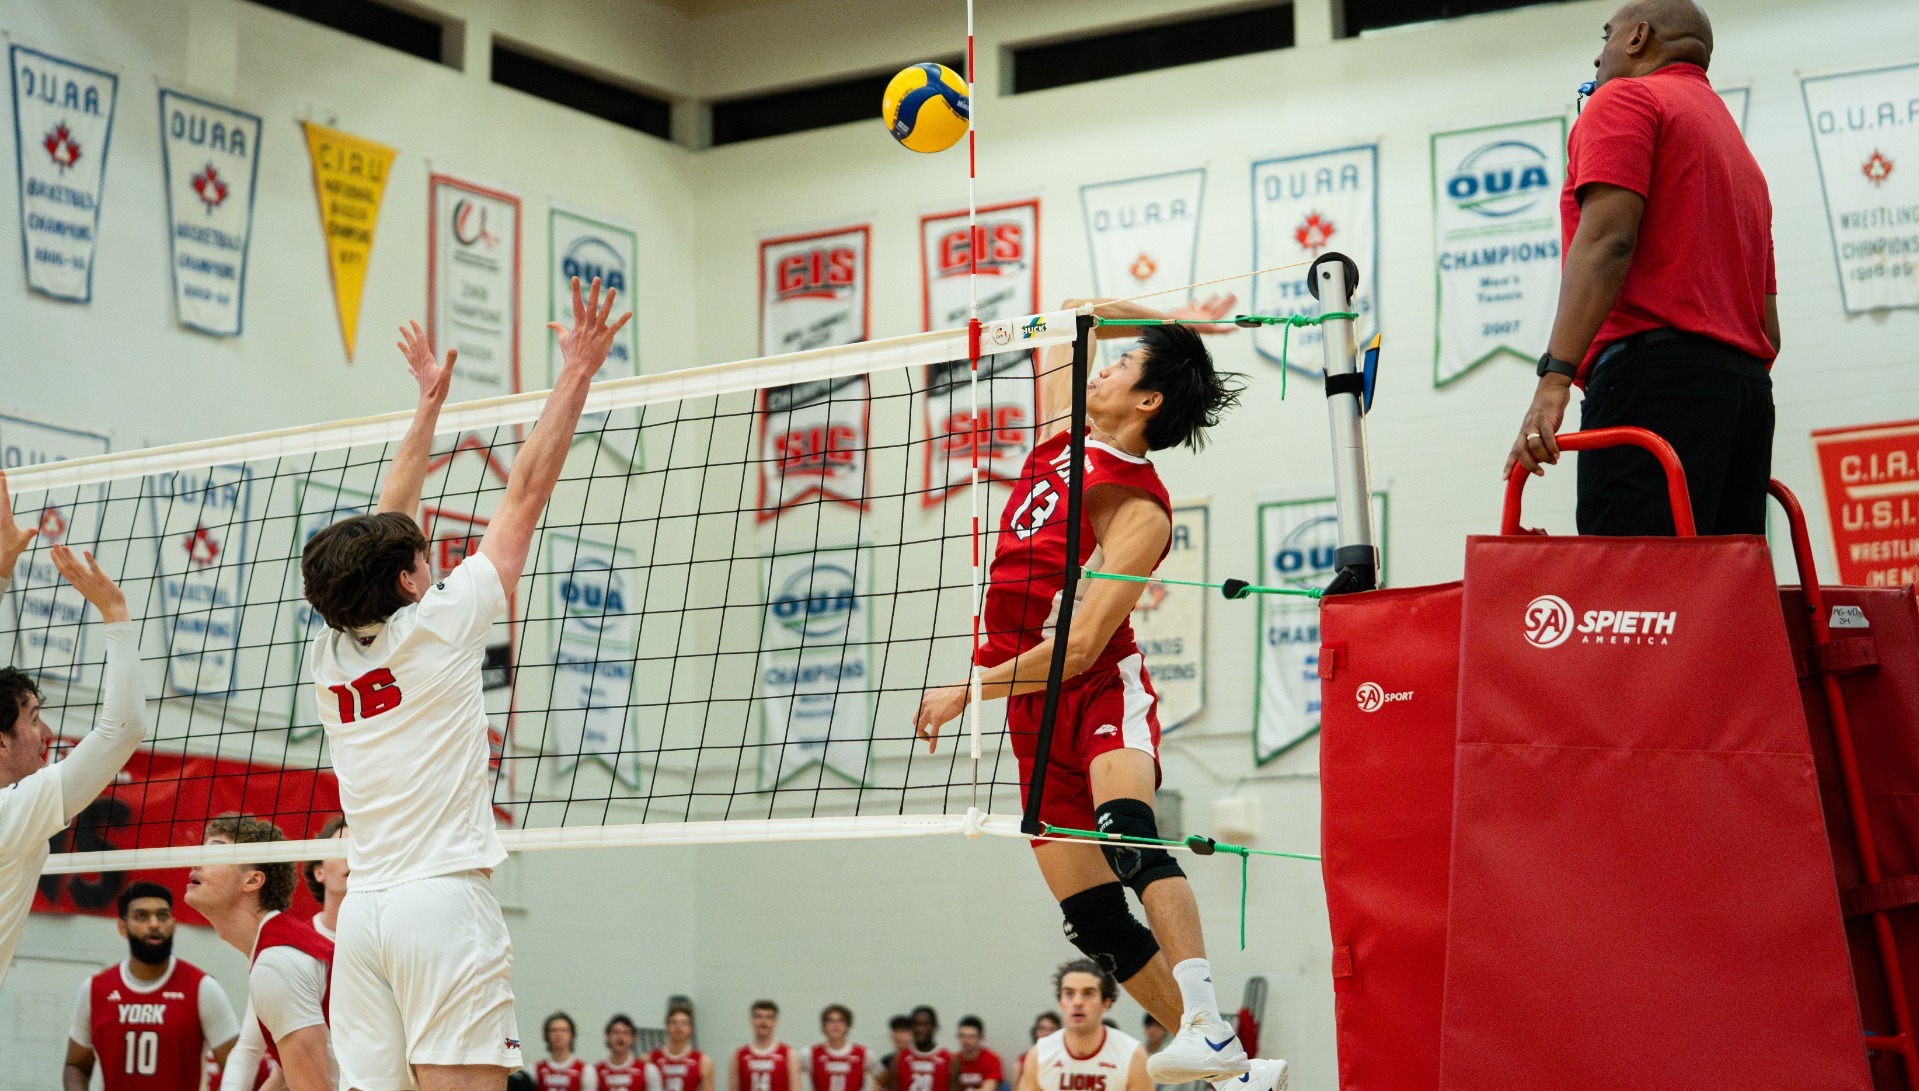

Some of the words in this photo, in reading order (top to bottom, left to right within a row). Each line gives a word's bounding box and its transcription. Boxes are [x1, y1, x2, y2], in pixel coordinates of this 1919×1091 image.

[1447, 165, 1551, 201] OUA
[938, 222, 1024, 273] CIS
[1439, 238, 1559, 270] CHAMPIONS
[562, 254, 626, 292] OUA
[775, 247, 856, 296] CIS
[1840, 450, 1919, 484] C.I.A.
[1009, 478, 1061, 542] 13
[1274, 550, 1335, 574] OU
[560, 578, 626, 612] OUA
[772, 588, 860, 618] OUA
[1577, 610, 1677, 635] SPIETH
[1582, 635, 1669, 646] AMERICA
[328, 667, 403, 724] 16
[1384, 690, 1414, 703] SPORT
[118, 1003, 167, 1025] YORK
[124, 1030, 159, 1076] 10
[1058, 1072, 1107, 1091] LIONS
